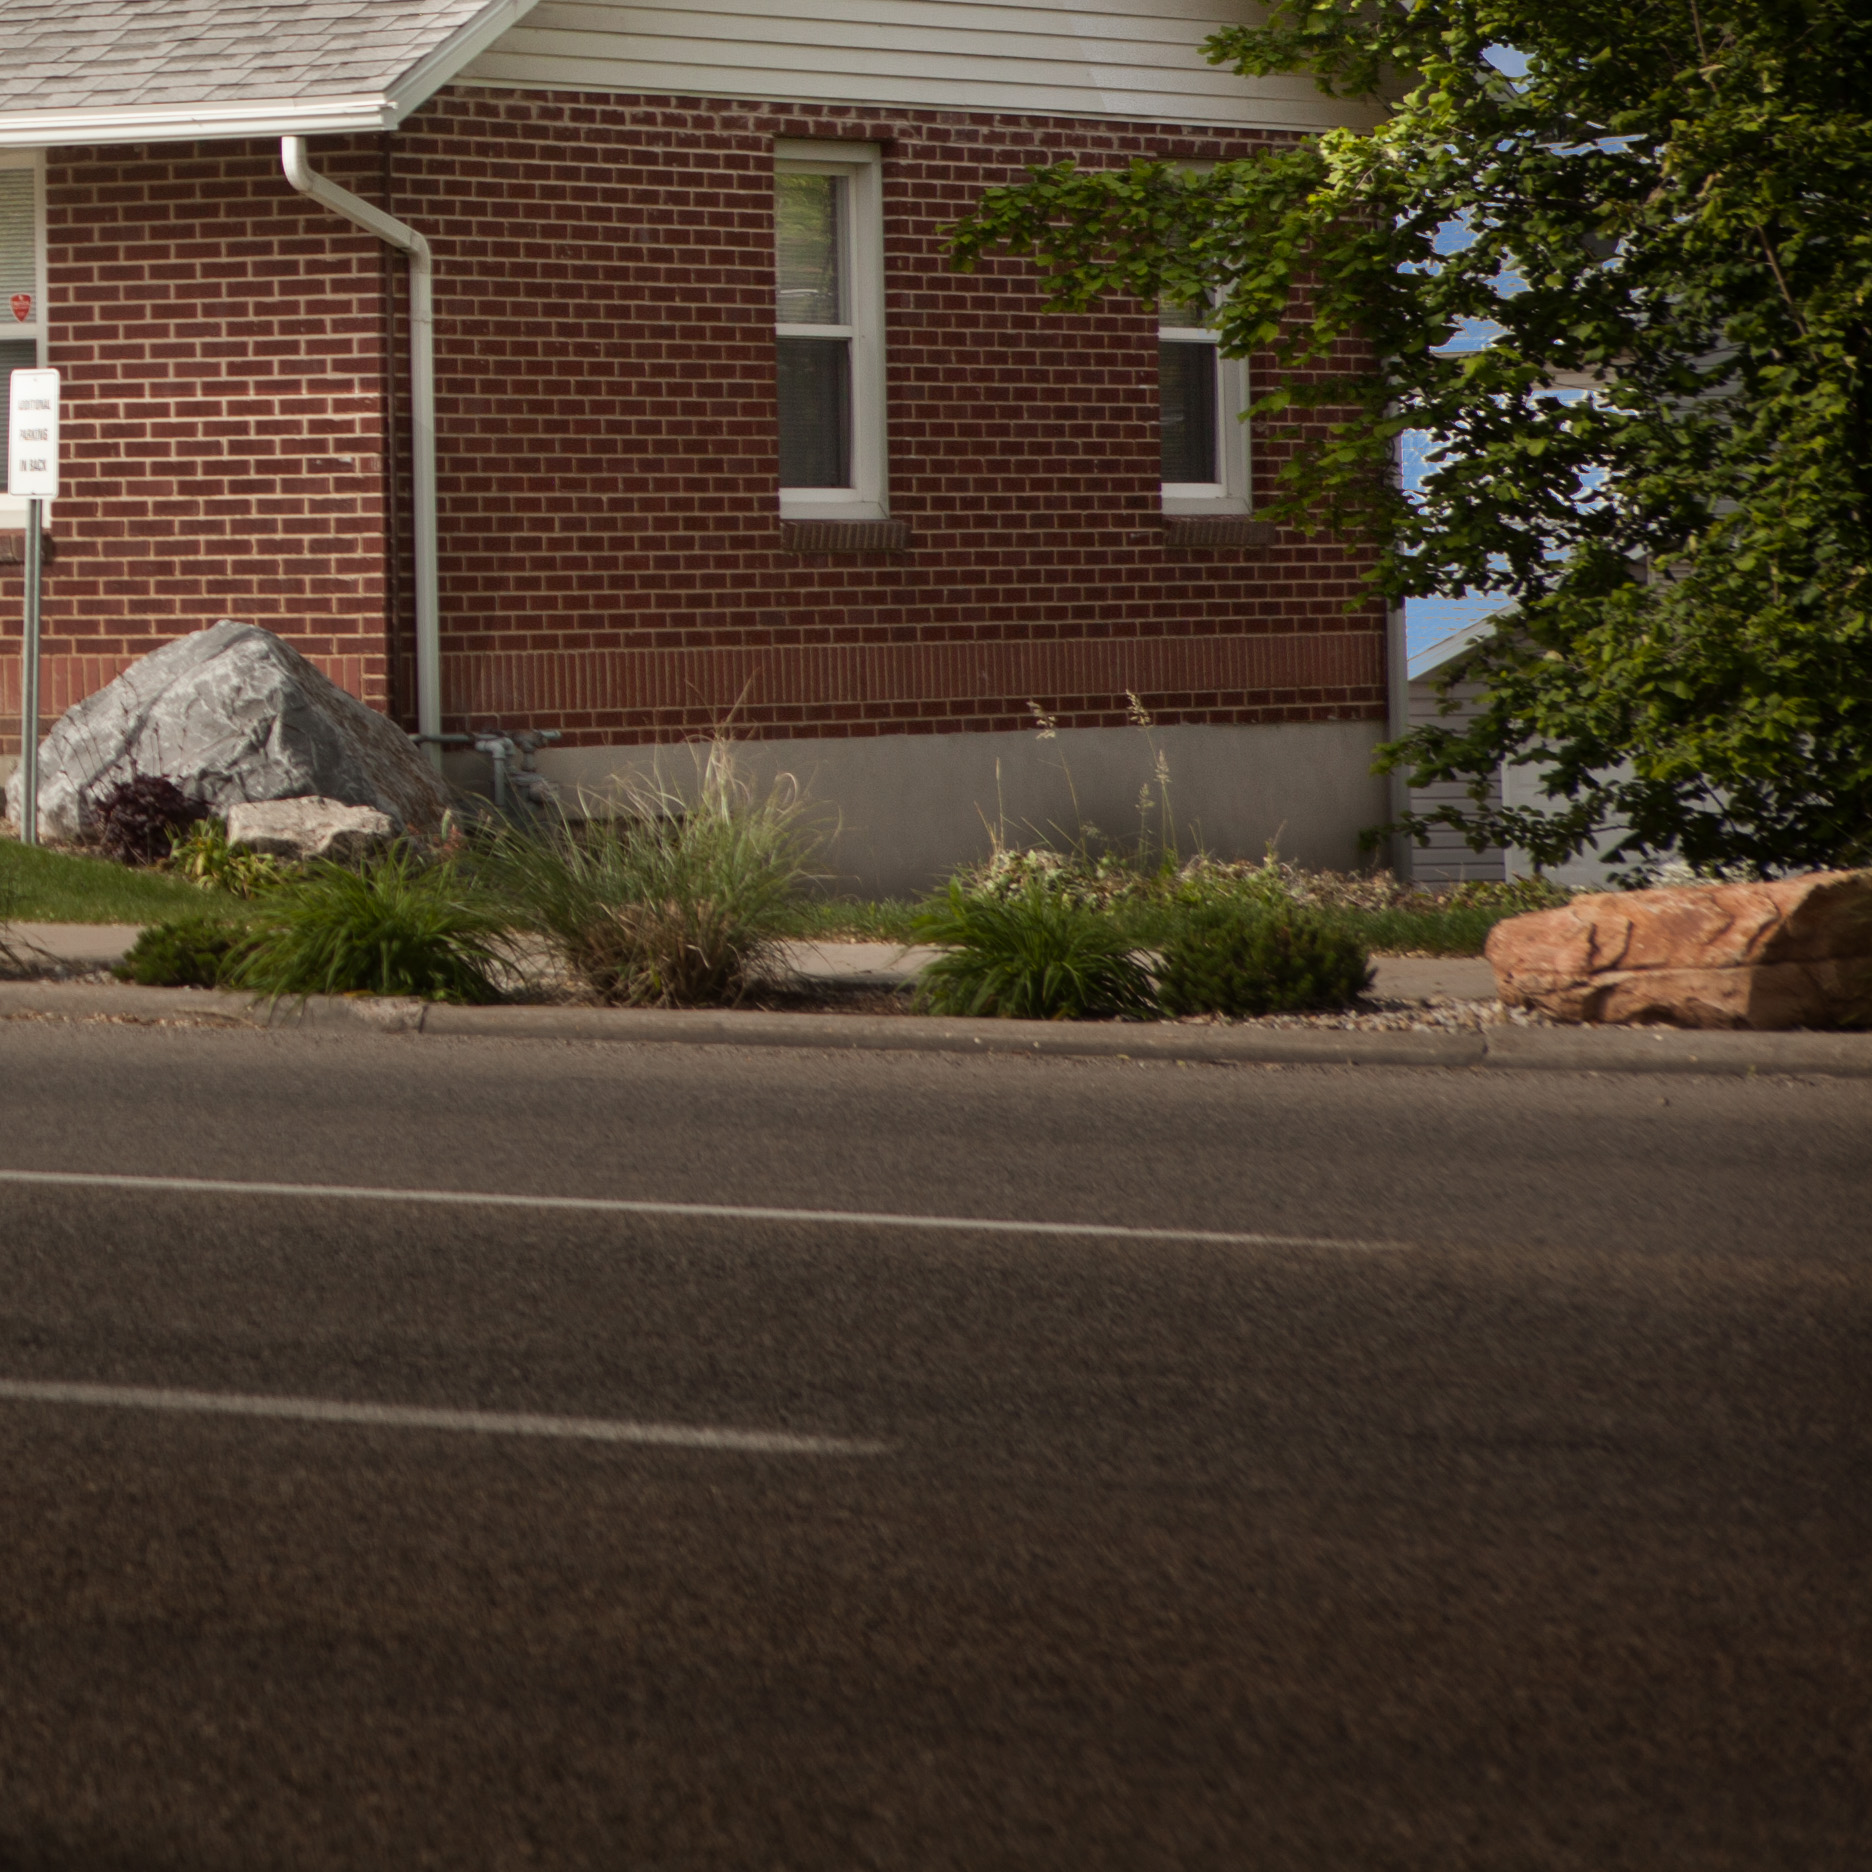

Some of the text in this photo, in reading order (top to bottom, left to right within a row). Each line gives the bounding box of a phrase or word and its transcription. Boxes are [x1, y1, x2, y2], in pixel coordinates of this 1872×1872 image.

[18, 399, 51, 410] ADDITIONAL
[20, 428, 48, 441] PARKING
[20, 459, 47, 472] IN BACK
